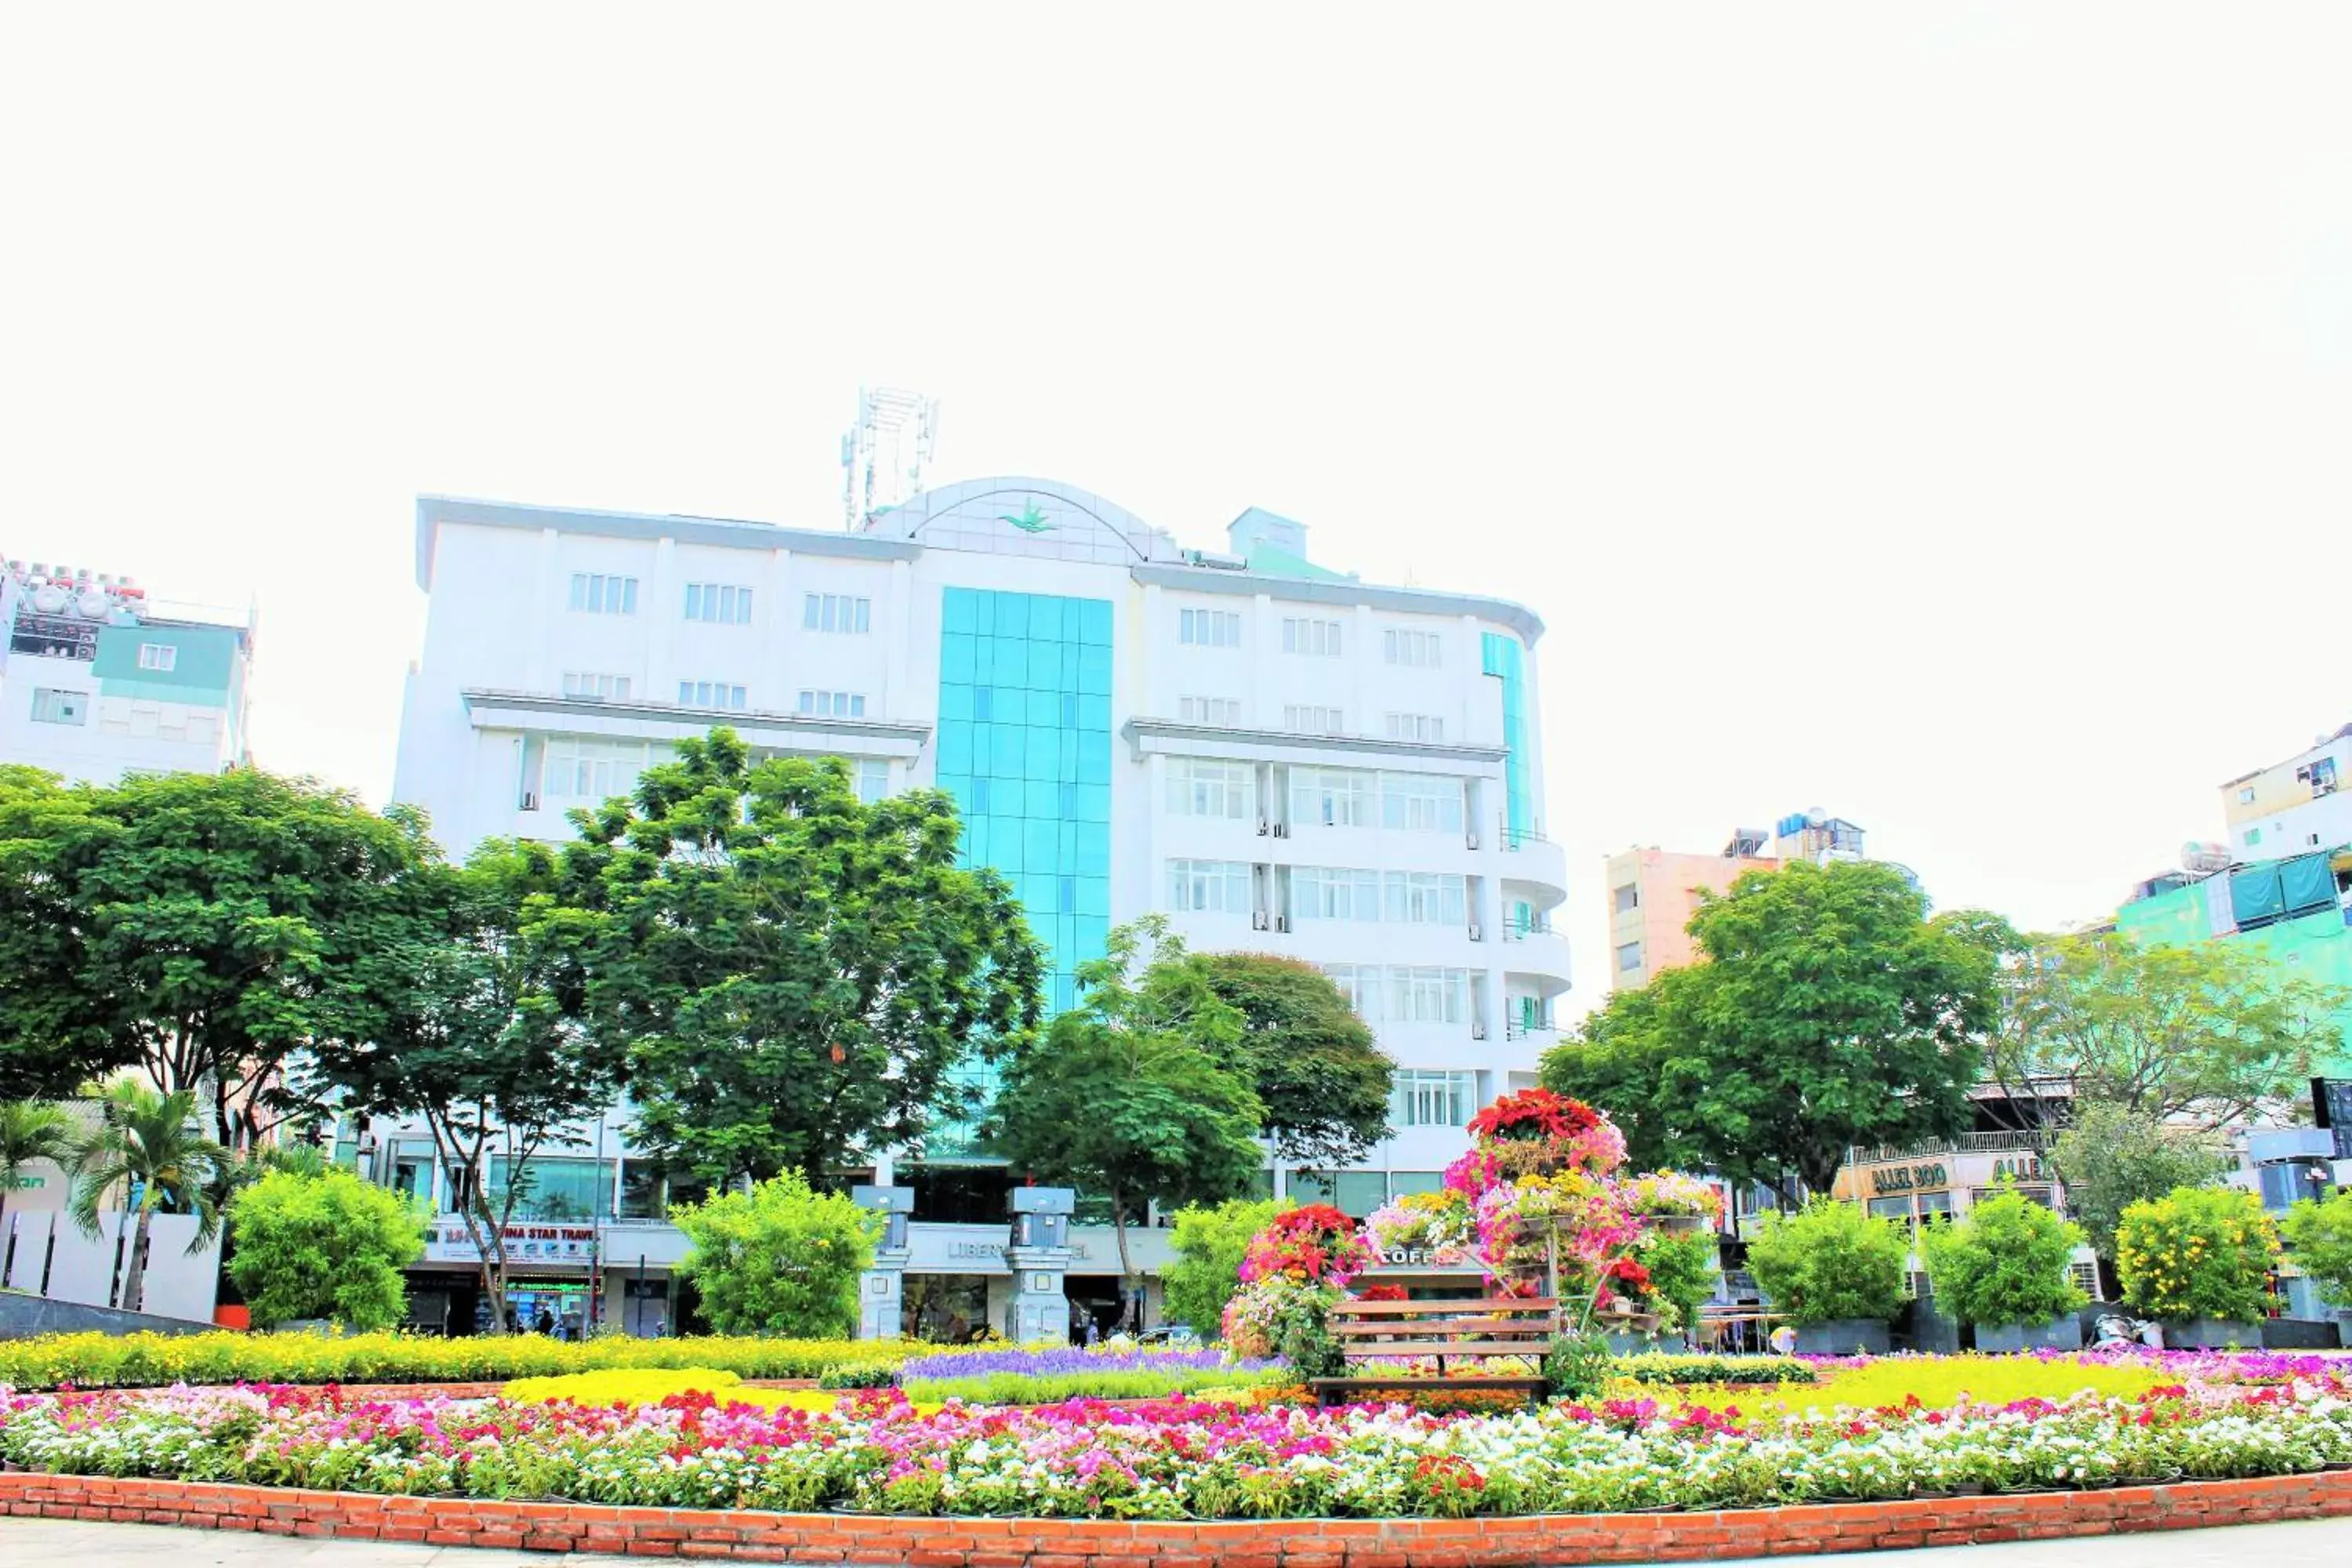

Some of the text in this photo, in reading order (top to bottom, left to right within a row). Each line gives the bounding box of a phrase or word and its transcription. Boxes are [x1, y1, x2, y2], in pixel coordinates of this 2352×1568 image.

[1871, 1166, 1911, 1191] ALLEZ
[528, 1228, 557, 1240] STAR
[561, 1229, 596, 1241] TRAVE
[947, 1241, 1004, 1259] LIBER
[1378, 1248, 1461, 1265] COFF
